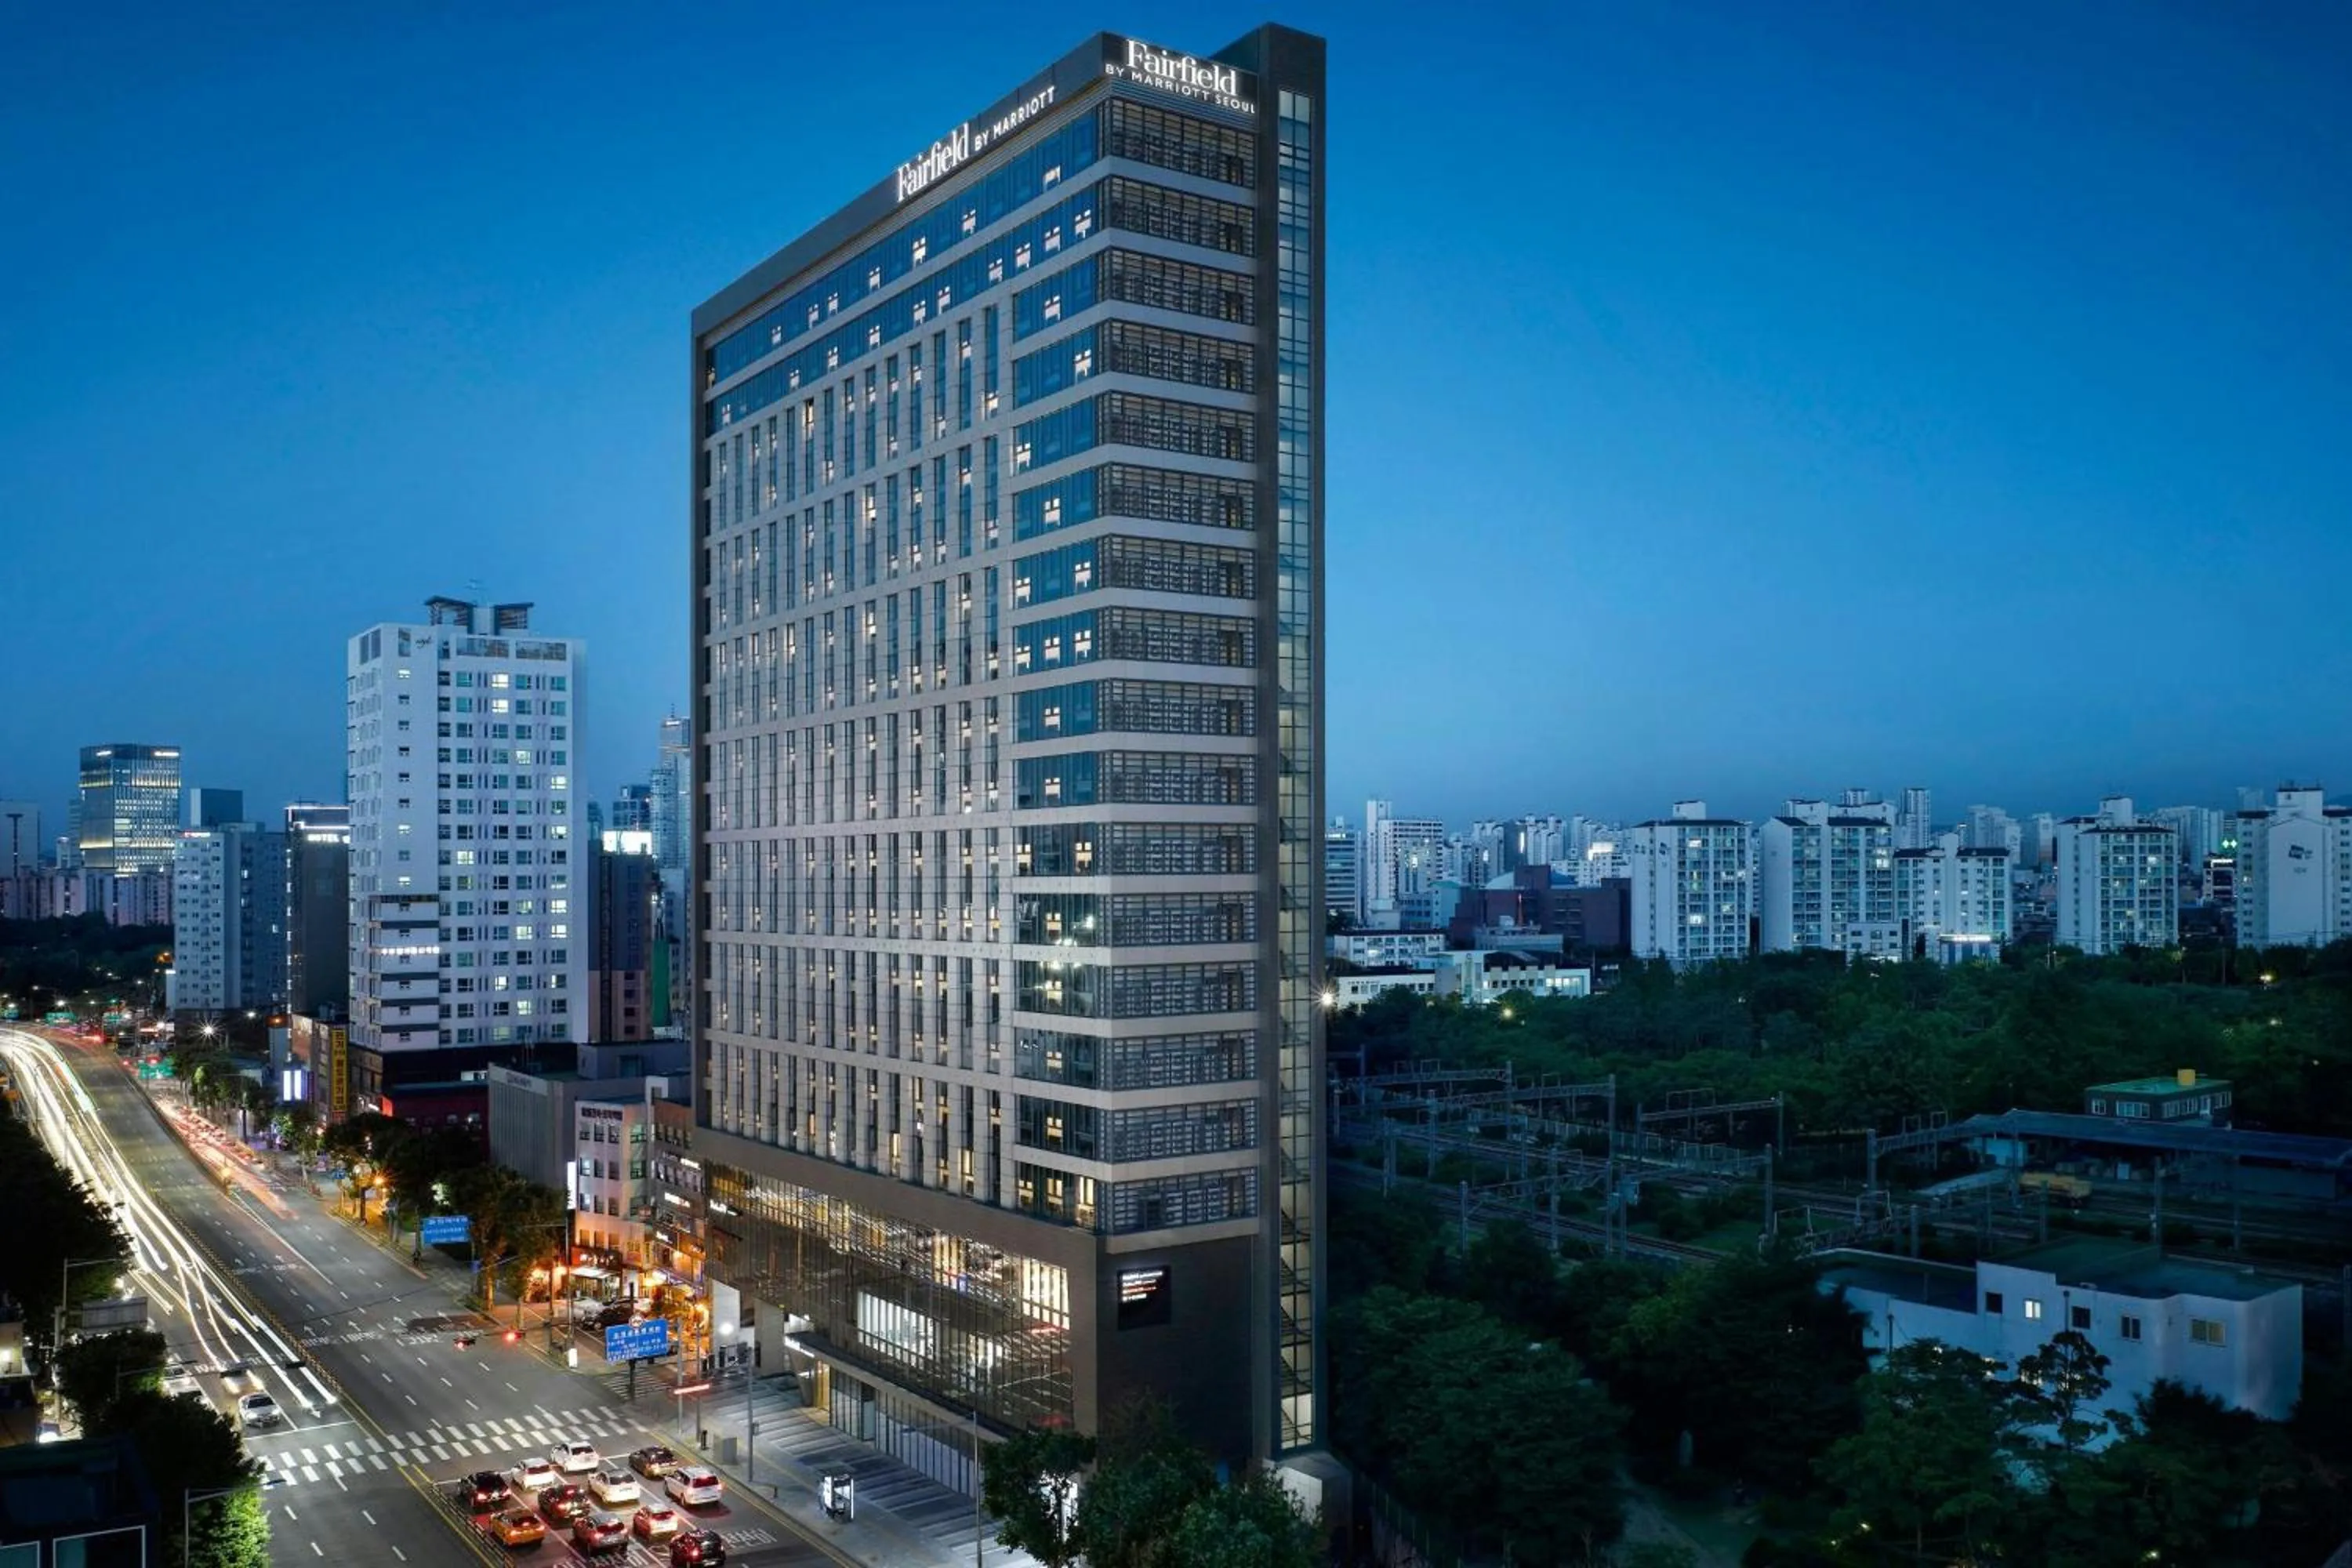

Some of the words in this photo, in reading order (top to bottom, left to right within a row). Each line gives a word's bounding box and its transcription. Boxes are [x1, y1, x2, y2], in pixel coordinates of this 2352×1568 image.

[1105, 63, 1124, 77] BY
[1131, 71, 1209, 100] MARRIOTT
[1215, 93, 1255, 114] SEOUL
[1126, 38, 1238, 96] Fairfield
[897, 122, 969, 202] Fairfield
[975, 129, 989, 151] BY
[993, 85, 1055, 140] MARRIOTT
